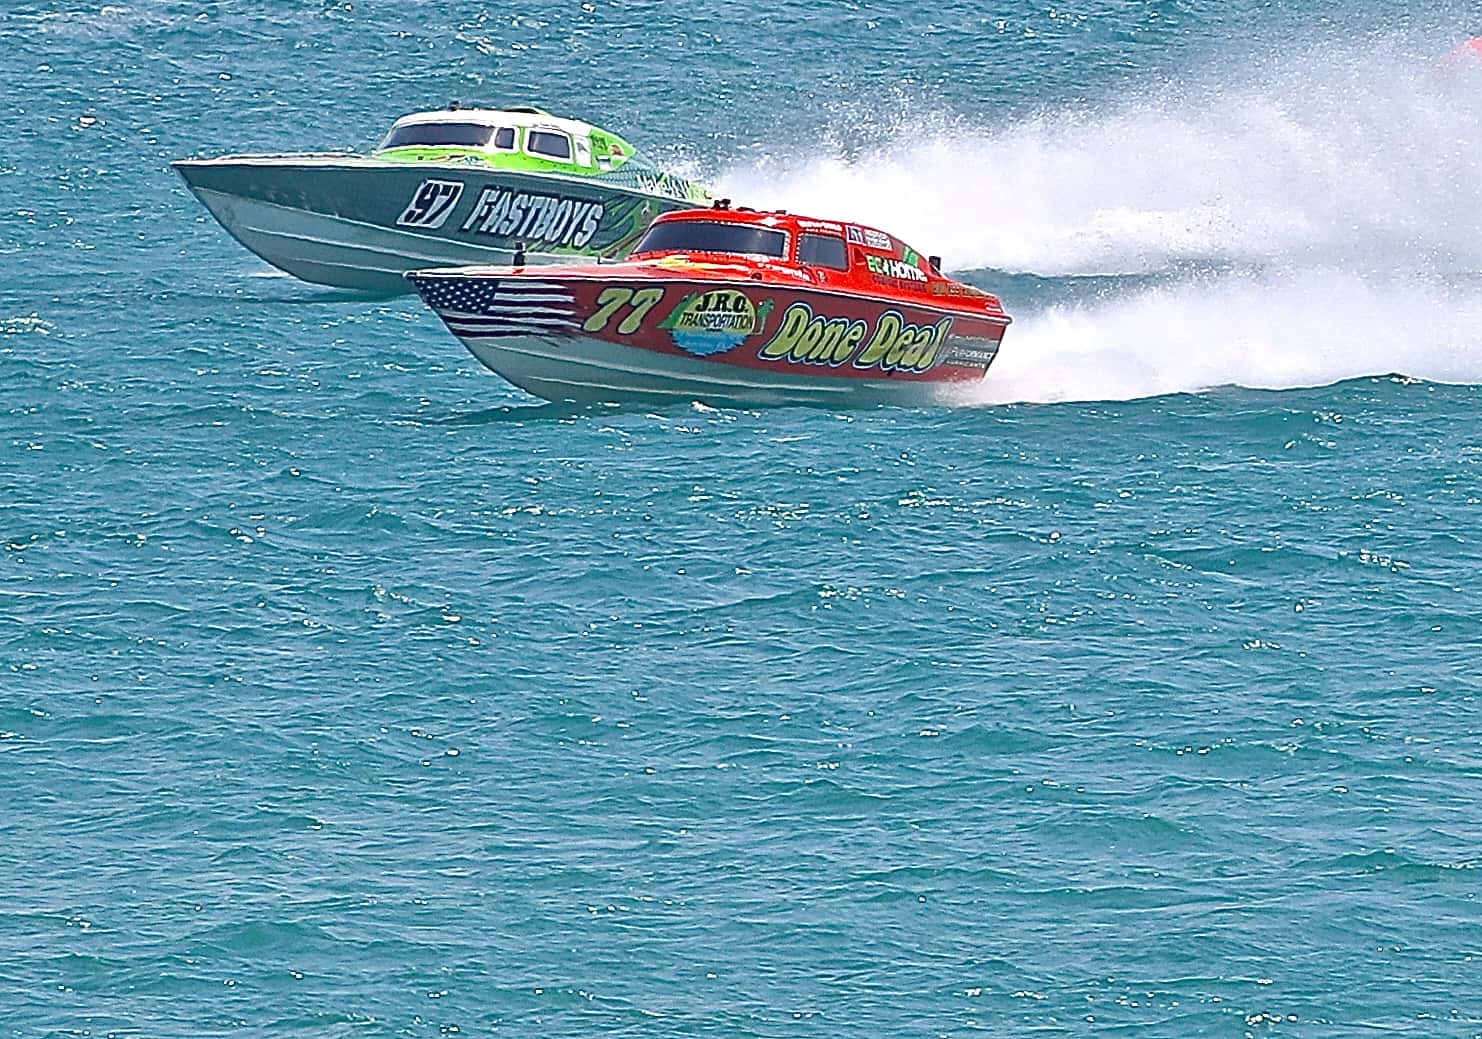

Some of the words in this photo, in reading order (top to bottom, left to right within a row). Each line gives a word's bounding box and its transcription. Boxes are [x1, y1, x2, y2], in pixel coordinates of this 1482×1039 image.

[401, 181, 464, 227] 97
[461, 188, 604, 248] FASTBOYS
[582, 286, 665, 335] 77
[680, 311, 754, 330] TRANSPORTATION
[760, 303, 866, 366] Done
[855, 311, 952, 372] Deal
